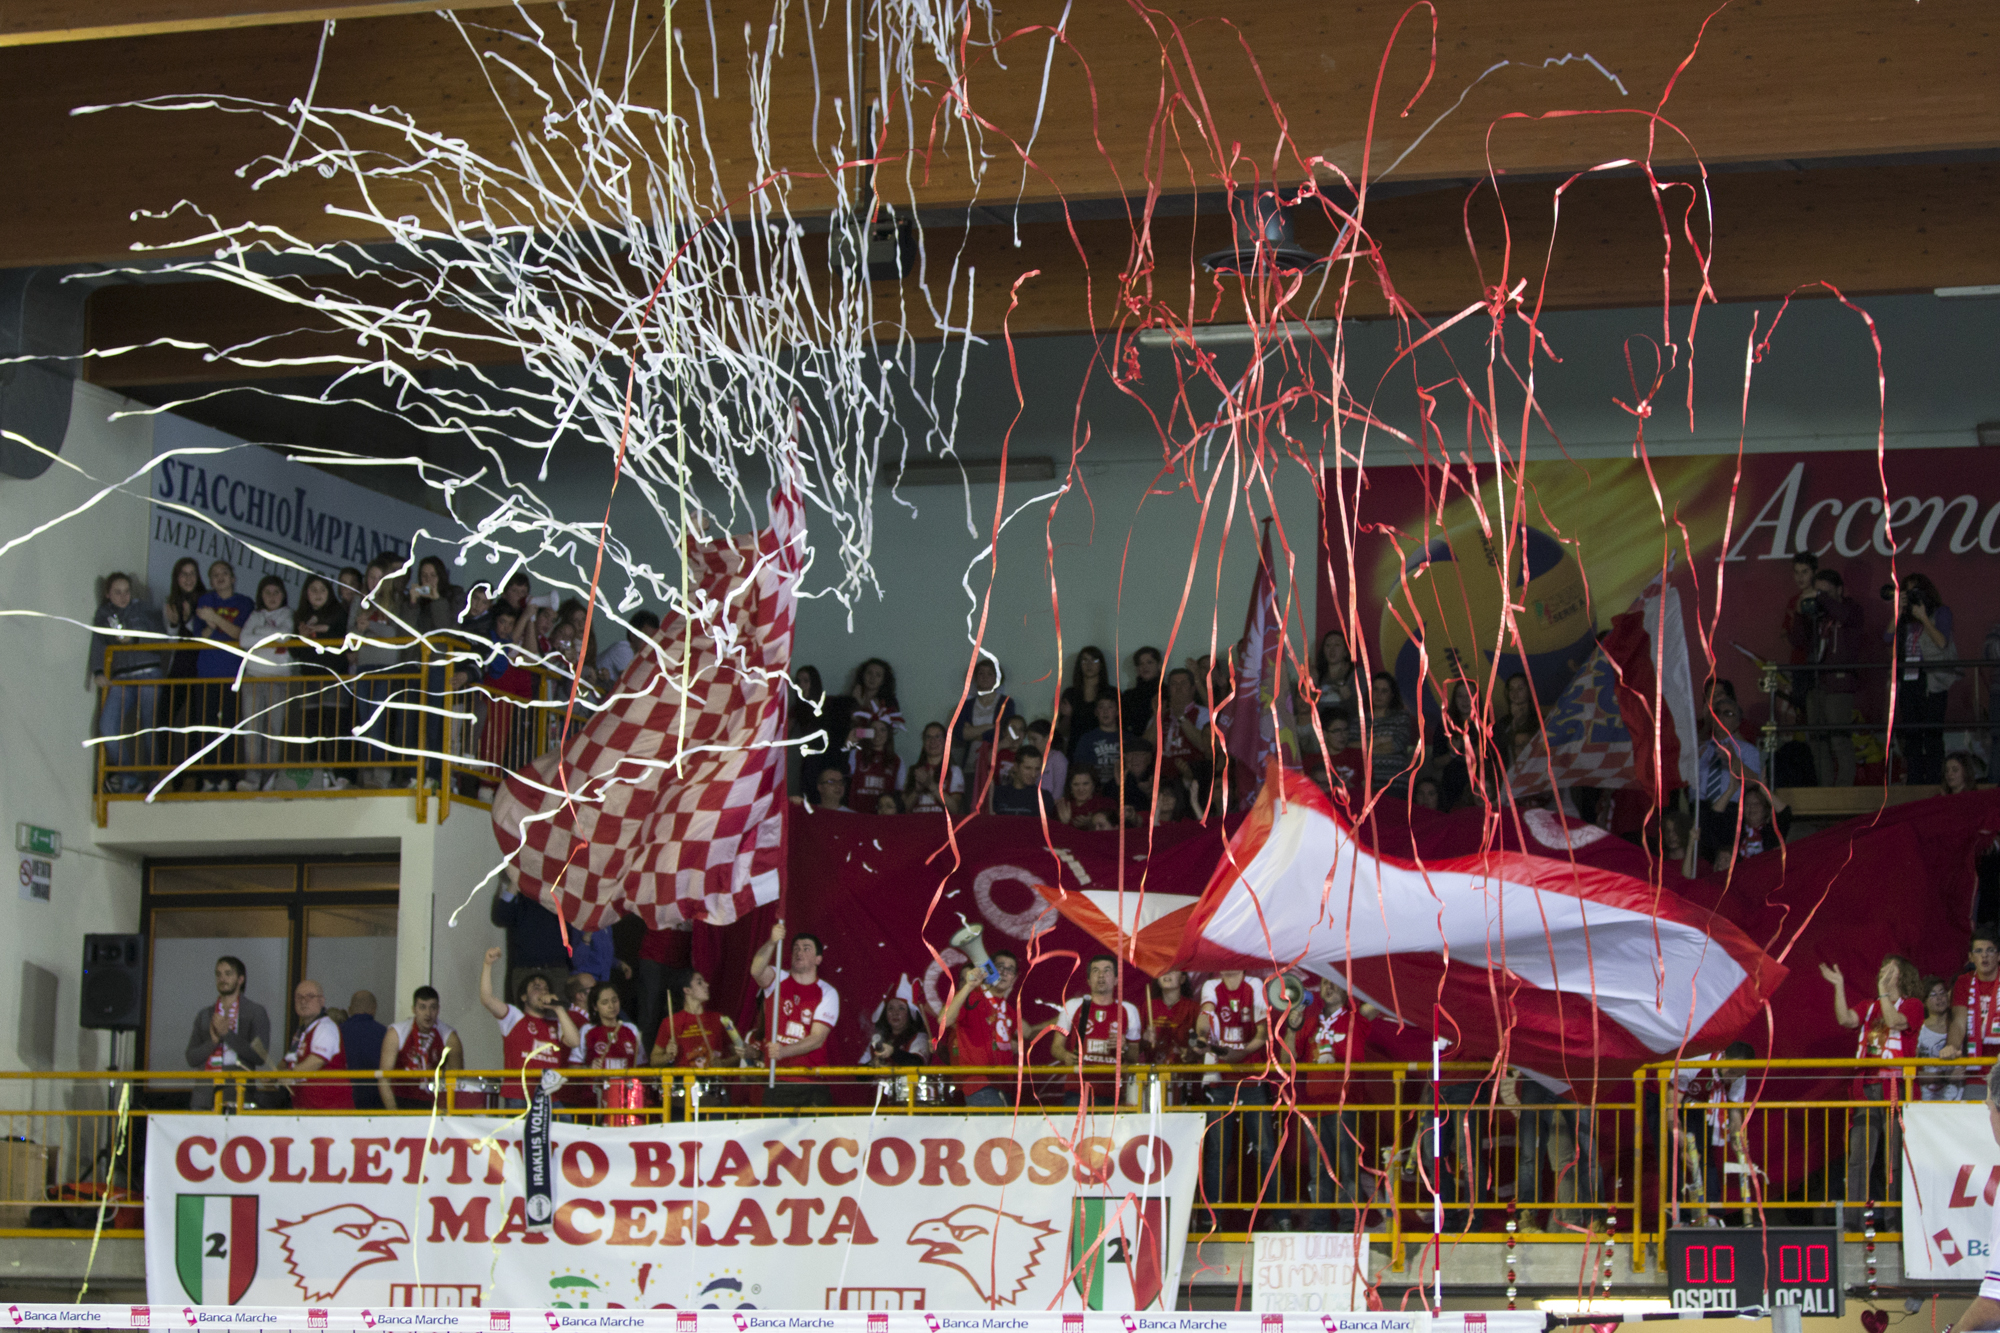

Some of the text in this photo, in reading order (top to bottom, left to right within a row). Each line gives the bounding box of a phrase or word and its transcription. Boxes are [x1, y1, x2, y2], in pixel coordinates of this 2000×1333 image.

[531, 1136, 544, 1187] IRAKLIS
[628, 1134, 1173, 1188] BIANCOROSSO
[426, 1196, 879, 1247] MACERATA
[204, 1232, 228, 1260] 2
[1107, 1238, 1133, 1264] 2
[1672, 1288, 1737, 1310] OSPITI
[1763, 1287, 1836, 1313] LOCALI
[24, 1311, 100, 1321] Banca Marche
[131, 1315, 150, 1326] LUBE
[199, 1313, 277, 1322] Banca Marche
[378, 1315, 458, 1324] Banca Marche
[562, 1317, 644, 1326] Banca Marche
[308, 1317, 327, 1328] LUBE
[490, 1319, 510, 1330] LUBE
[677, 1321, 697, 1332] LUBE
[750, 1318, 834, 1328] Banca Marche
[868, 1322, 888, 1333] LUBE
[943, 1319, 1028, 1328] Banca Marche
[1140, 1319, 1227, 1329] Banca Marche
[1340, 1320, 1377, 1330] Banca
